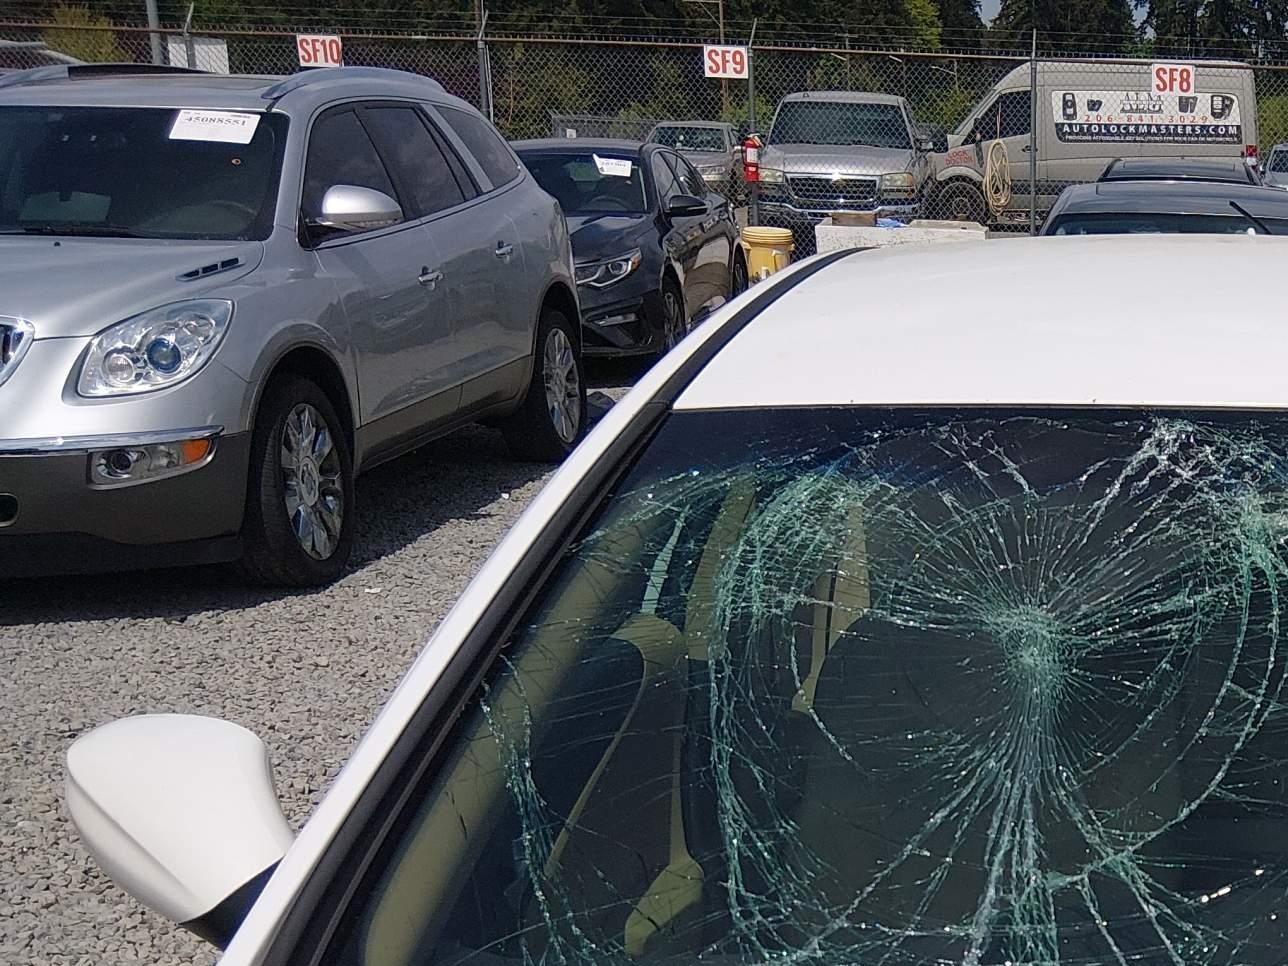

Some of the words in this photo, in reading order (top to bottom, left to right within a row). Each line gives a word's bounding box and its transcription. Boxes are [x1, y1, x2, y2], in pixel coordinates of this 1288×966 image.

[300, 38, 340, 64] SF10
[707, 49, 745, 75] SF9
[1155, 67, 1191, 93] SF8
[184, 116, 247, 126] 45088551
[1063, 124, 1238, 135] AUTOLOCKMASTERS.COM
